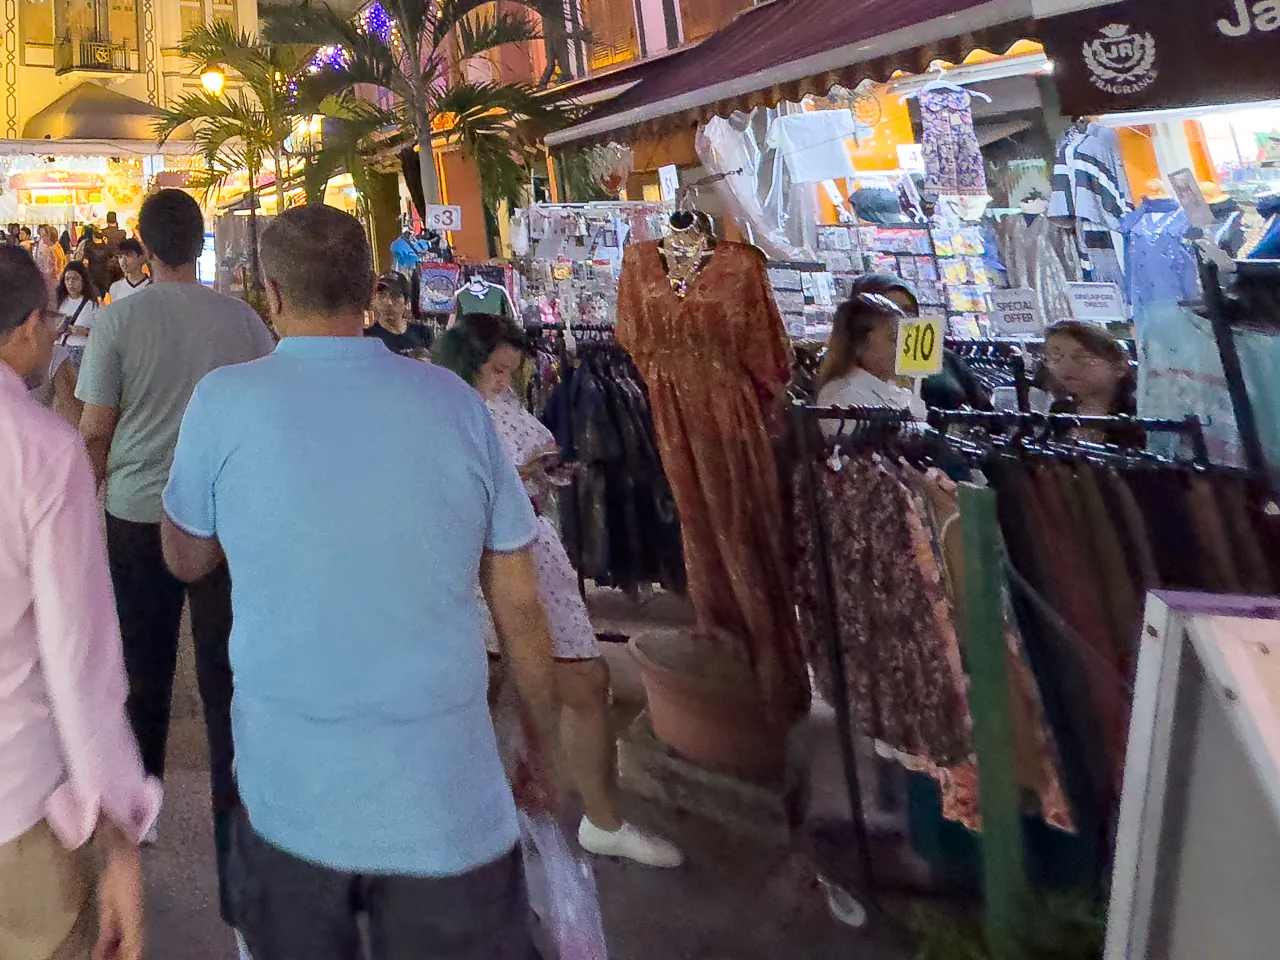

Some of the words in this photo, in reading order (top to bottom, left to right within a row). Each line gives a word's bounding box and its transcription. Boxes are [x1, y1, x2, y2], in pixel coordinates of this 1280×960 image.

[996, 301, 1035, 312] SPECIAL
[1003, 313, 1034, 324] OFFER
[902, 322, 935, 361] $10
